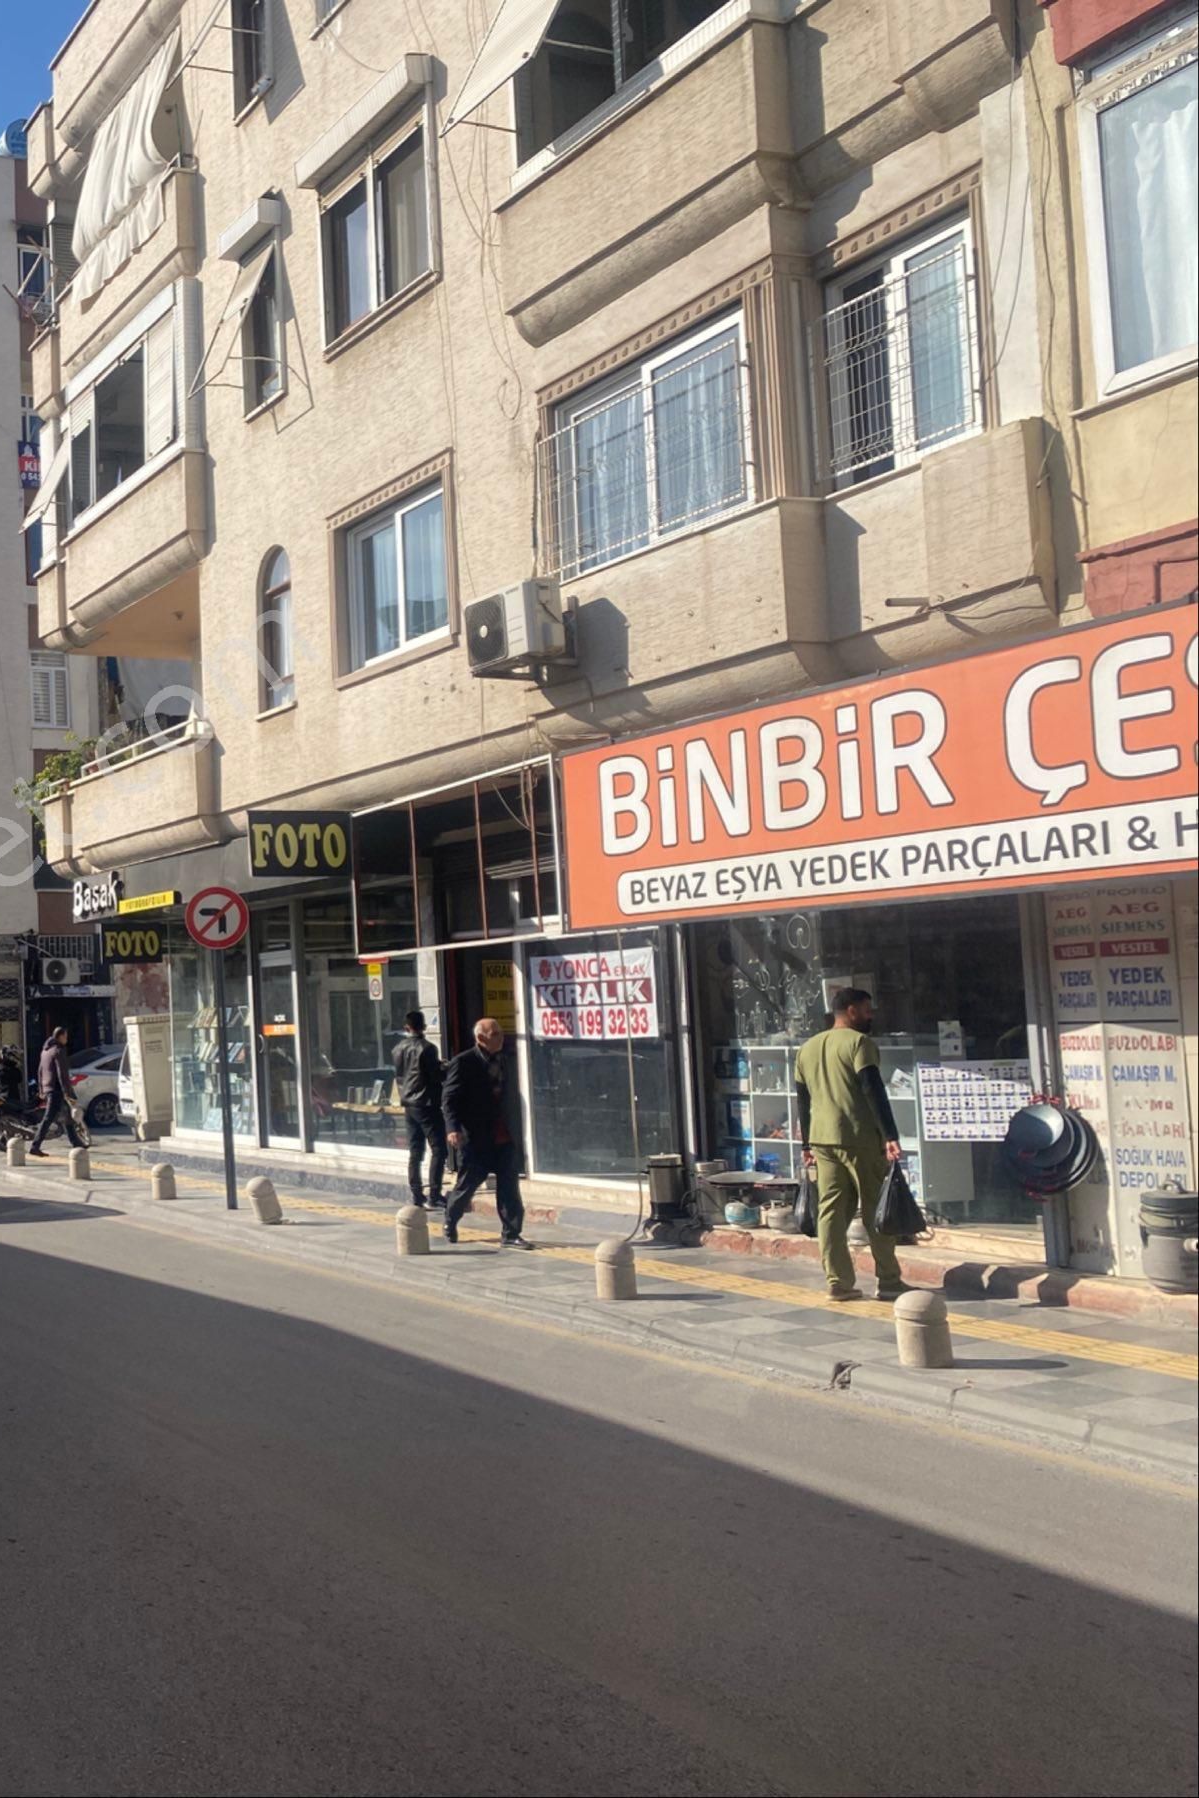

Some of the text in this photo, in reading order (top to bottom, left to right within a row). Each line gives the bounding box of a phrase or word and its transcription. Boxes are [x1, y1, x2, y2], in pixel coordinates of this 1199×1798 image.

[1003, 632, 1198, 808] ÇE
[251, 823, 347, 868] FOTO
[630, 872, 708, 906] BEYAZ
[715, 862, 782, 901] EŞYA
[790, 847, 891, 886] YEDEK
[901, 820, 1111, 877] PARÇALARI
[1127, 815, 1159, 852] &
[73, 871, 119, 917] Başak
[1055, 906, 1087, 921] AEG
[1106, 901, 1160, 916] AEG
[1101, 919, 1166, 934] SIEMENS
[104, 930, 160, 957] FOTO
[1110, 941, 1156, 955] VESTEL
[553, 957, 611, 980] YONCA
[1059, 970, 1094, 987] YEDEK
[1108, 966, 1166, 985] YEDEK
[1107, 989, 1172, 1012] PARÇALARI
[542, 1007, 649, 1036] 0553 199 32 33
[1111, 1064, 1178, 1087] ÇAMAŞIR M.
[1115, 1145, 1153, 1167] SOĞUK
[1156, 1148, 1186, 1167] HAVA
